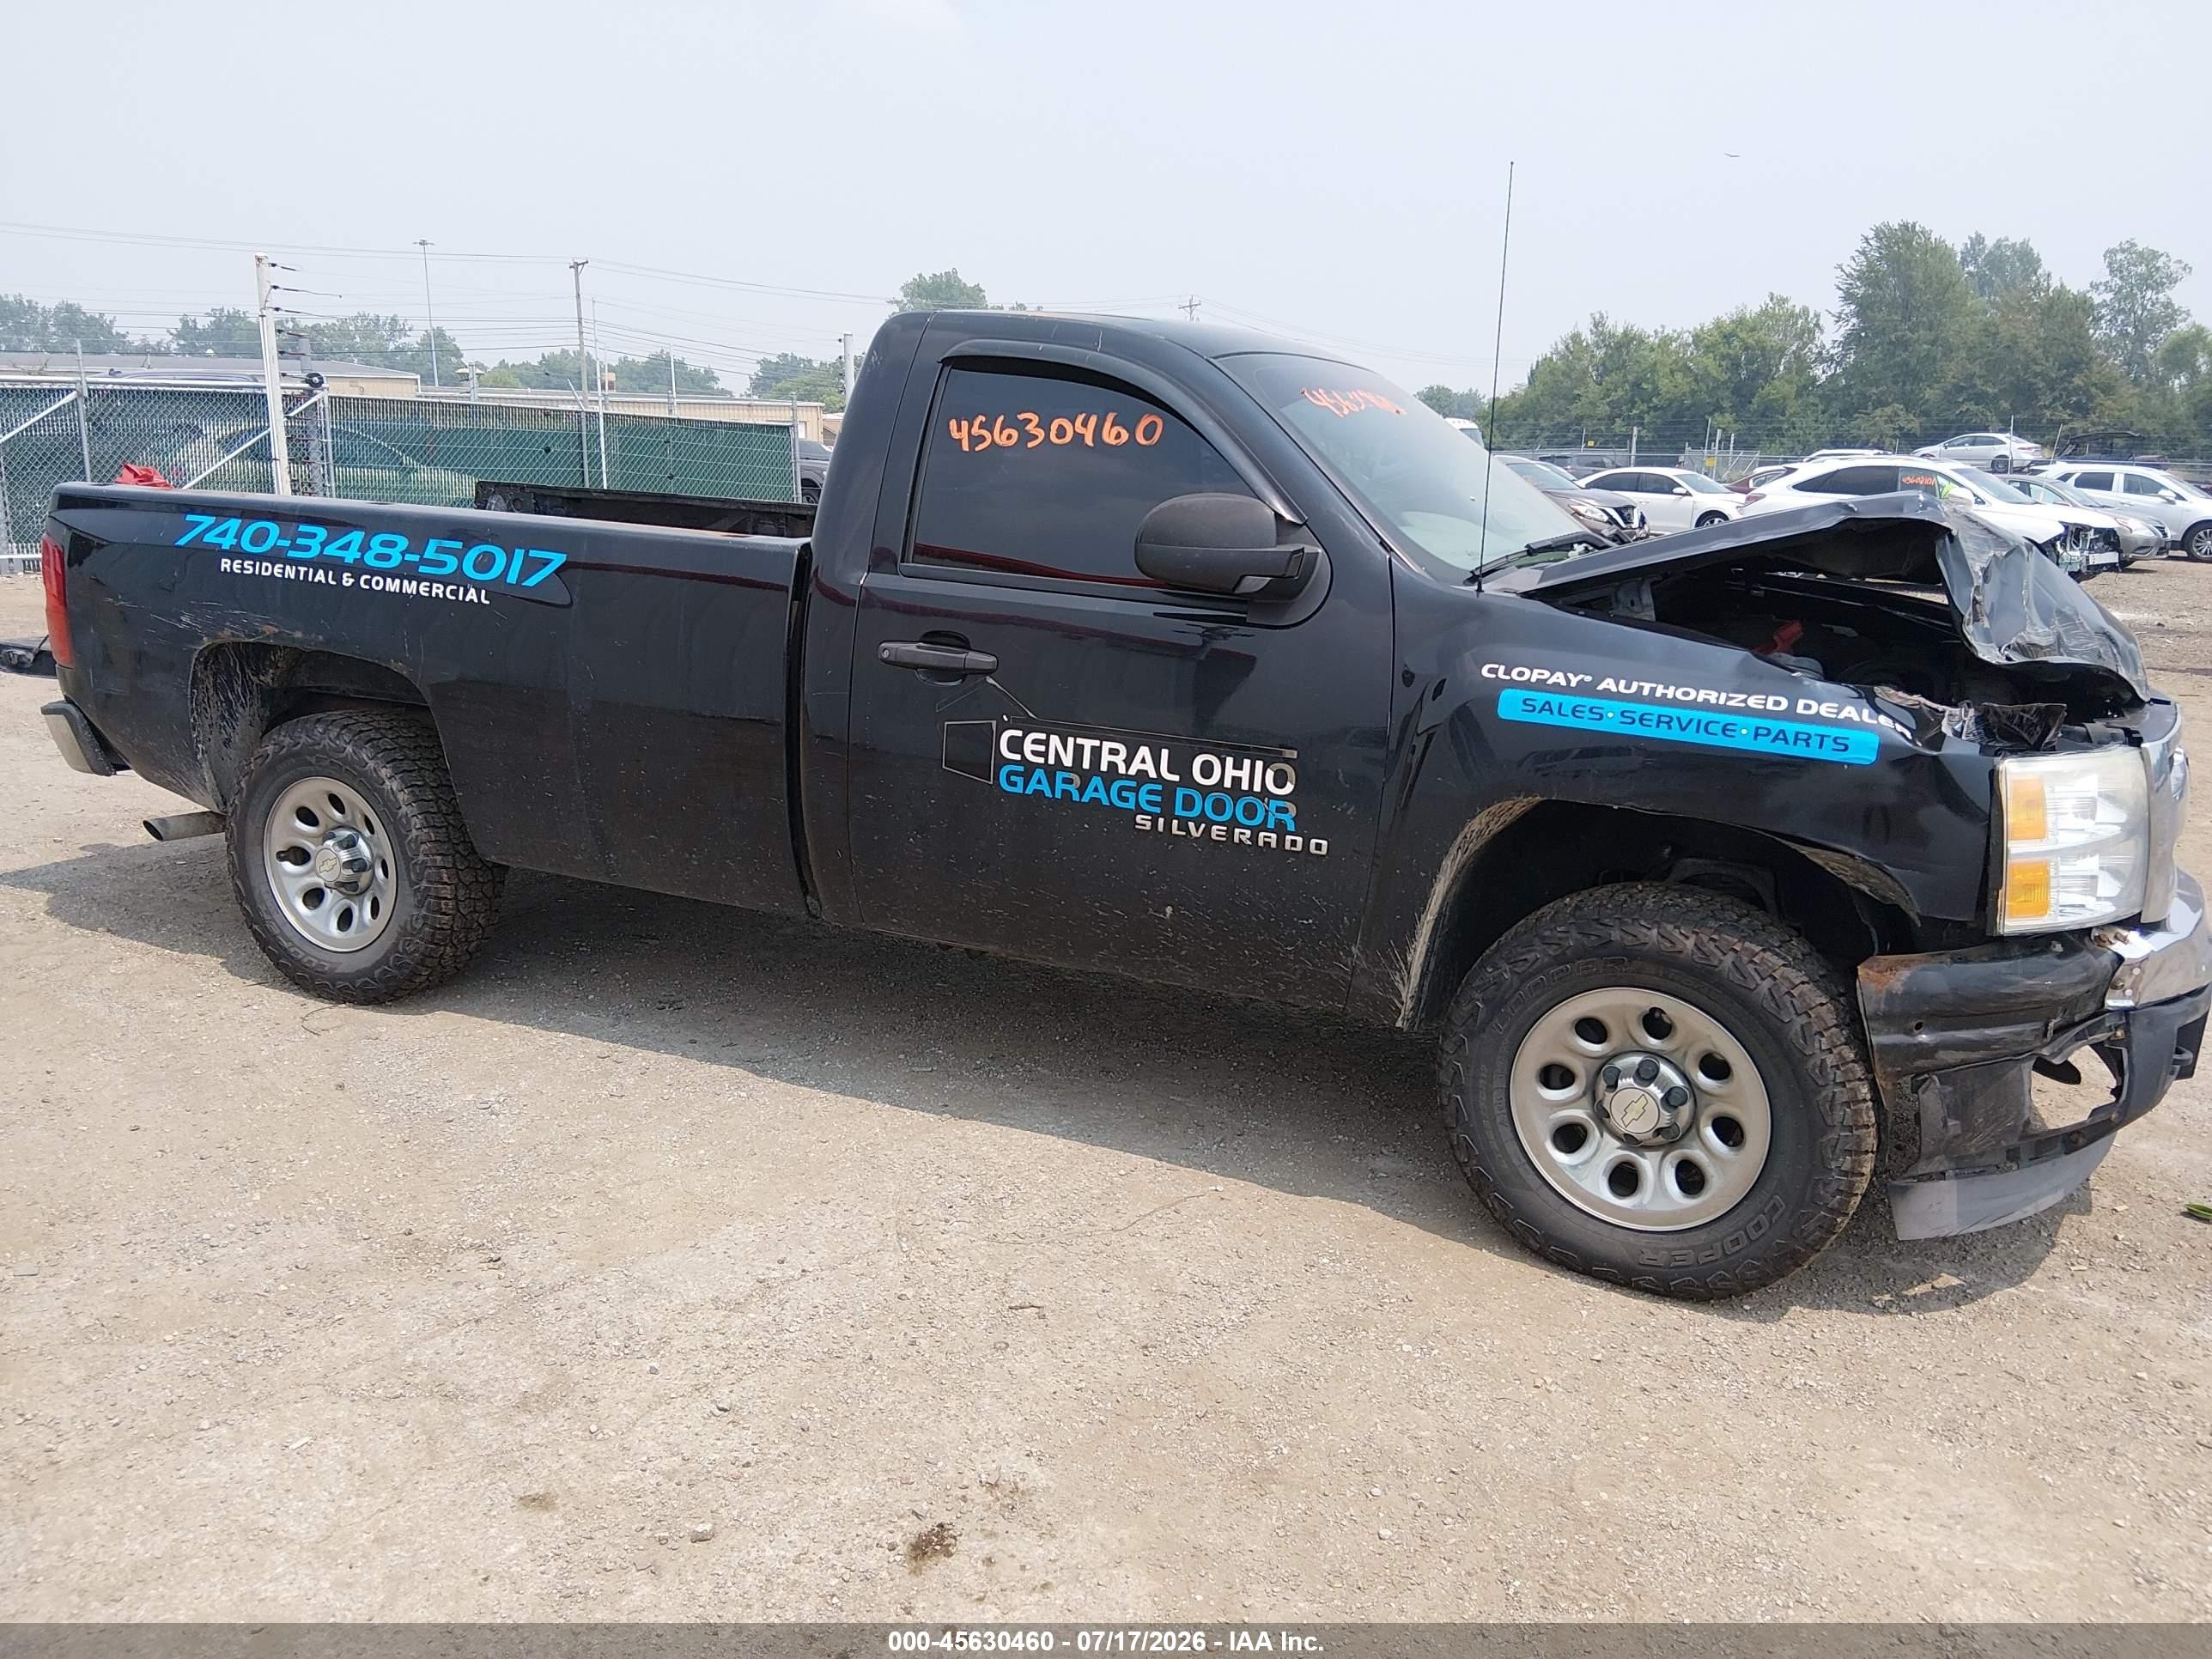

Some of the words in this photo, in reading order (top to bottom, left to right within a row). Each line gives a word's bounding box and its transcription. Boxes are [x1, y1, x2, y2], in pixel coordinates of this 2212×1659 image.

[949, 412, 1164, 452] 45630460
[174, 514, 567, 587] 740-348-5017
[221, 558, 337, 586] RESIDENTIAL
[342, 571, 355, 587] &
[359, 574, 490, 604] COMMERCIAL
[1596, 678, 1788, 712] AUTHORIZED
[1000, 728, 1181, 782] CENTRAL
[1192, 753, 1296, 796] OHIO
[999, 764, 1163, 814] GARAGE
[1175, 787, 1297, 832] DOOR
[1134, 814, 1329, 856] SILVERADO
[1638, 1194, 1786, 1267] COOPER
